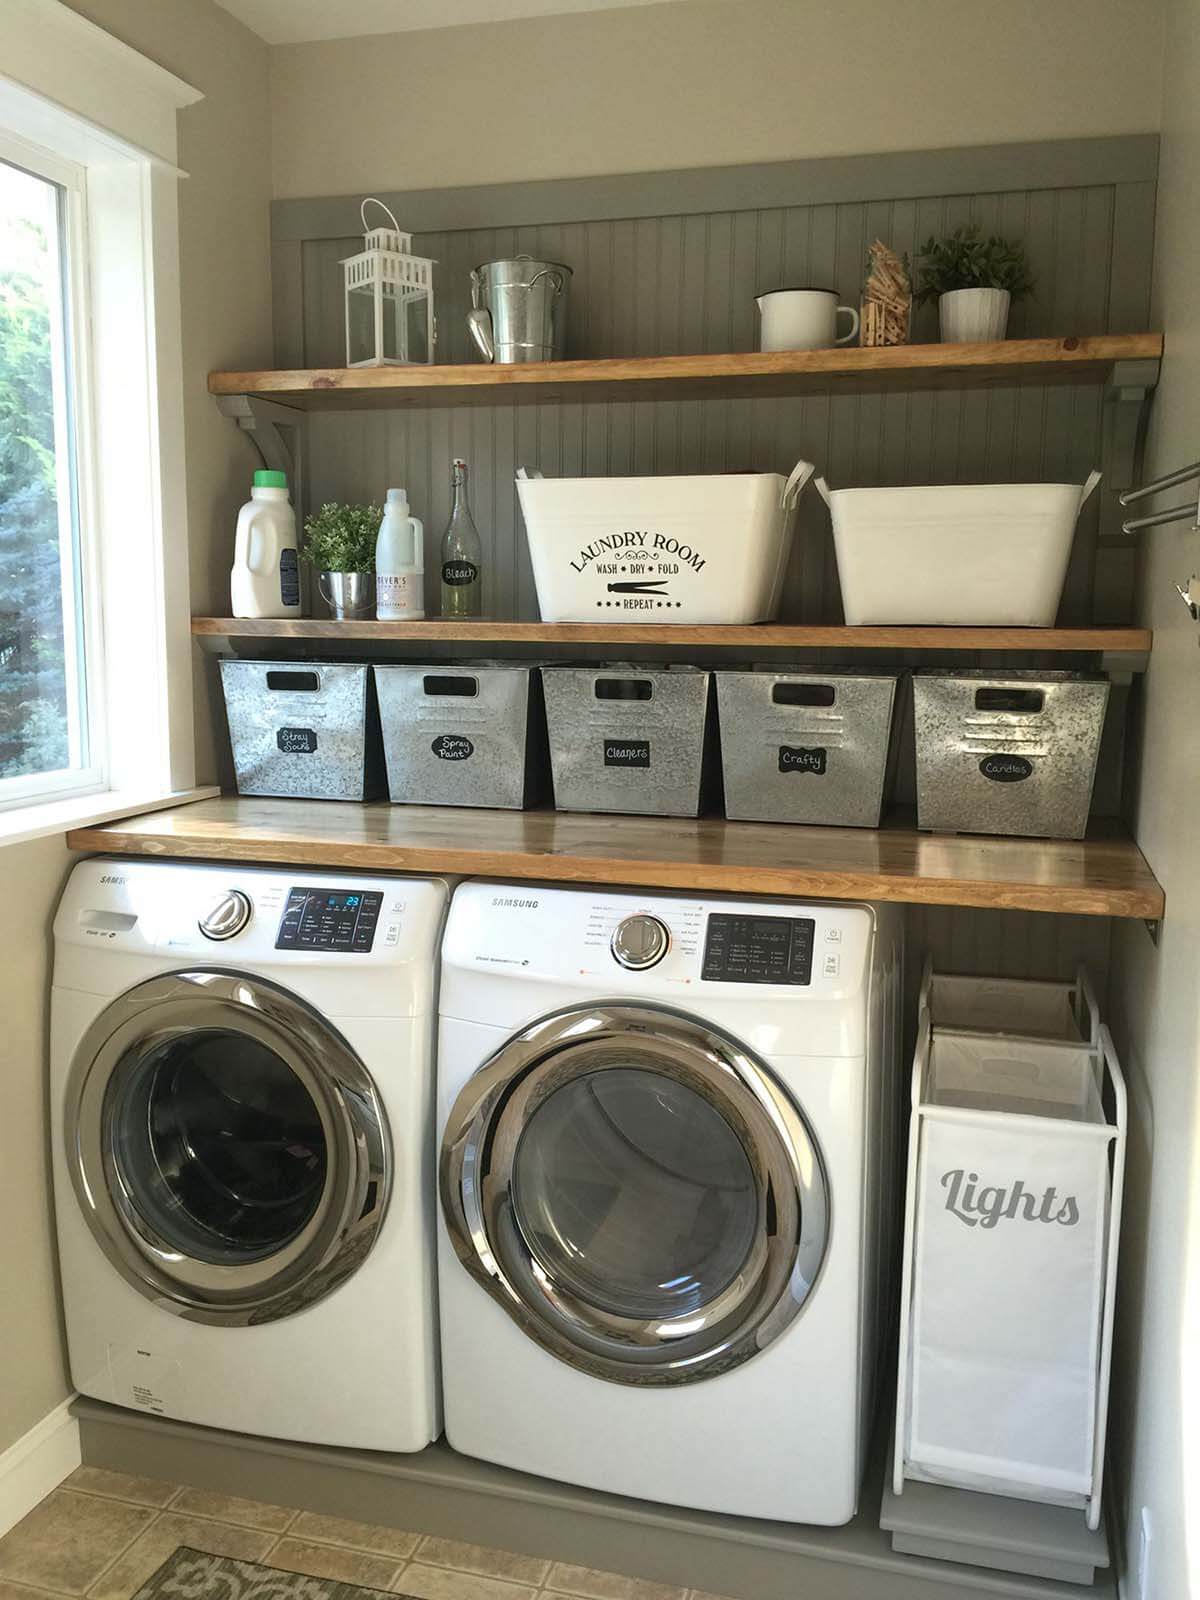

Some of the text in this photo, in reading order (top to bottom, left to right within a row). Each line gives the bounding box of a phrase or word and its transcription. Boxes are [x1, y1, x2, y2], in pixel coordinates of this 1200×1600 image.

[570, 531, 707, 573] LAUNDRY ROOM
[445, 567, 475, 581] Bleach
[596, 563, 679, 574] WASH DRY FOLD
[623, 599, 654, 610] REPEAT
[442, 736, 470, 753] Spray
[438, 748, 465, 758] Paint
[606, 747, 648, 760] Cleaners
[782, 752, 821, 770] Crafty
[985, 762, 1028, 774] Candles
[346, 896, 359, 906] 23
[492, 897, 540, 909] SAMSUNG
[940, 1169, 1080, 1229] Lights
